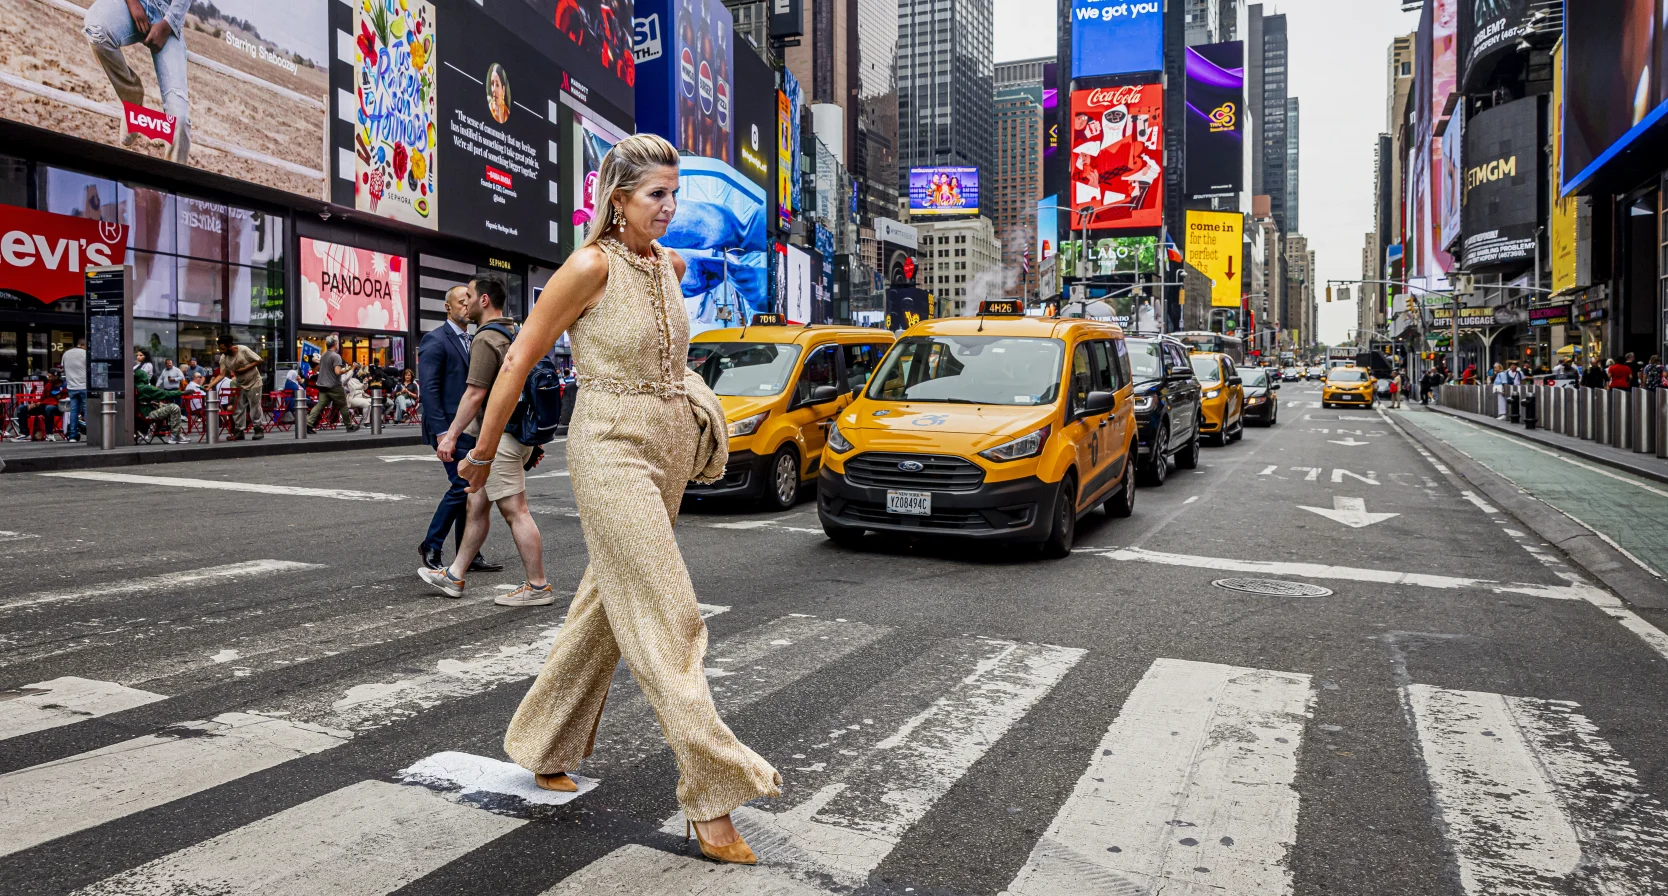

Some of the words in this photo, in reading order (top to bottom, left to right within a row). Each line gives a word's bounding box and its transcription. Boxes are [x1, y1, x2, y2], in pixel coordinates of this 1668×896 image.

[1076, 7, 1099, 20] We
[1102, 3, 1127, 21] got
[1130, 2, 1158, 18] you
[226, 30, 257, 58] Starring
[259, 45, 298, 75] Shaboozey
[392, 40, 411, 71] Tus
[390, 91, 412, 117] son
[450, 120, 460, 132] has
[474, 146, 482, 156] part
[387, 192, 412, 206] SEPHORA
[1190, 222, 1220, 232] come
[1222, 222, 1234, 232] in
[1190, 232, 1202, 244] for
[1203, 232, 1216, 245] the
[0, 230, 112, 272] evi's
[1088, 246, 1128, 260] LALO
[1500, 242, 1536, 252] PROBLEM?
[1190, 247, 1218, 262] perfect
[489, 258, 511, 270] SEPHORA
[1193, 260, 1208, 274] ifts
[321, 271, 392, 300] PANDORA
[990, 303, 1012, 313] 4H26
[1461, 308, 1494, 317] OPENING
[1460, 316, 1494, 325] LUGGAGE
[891, 496, 926, 510] Y208494C
